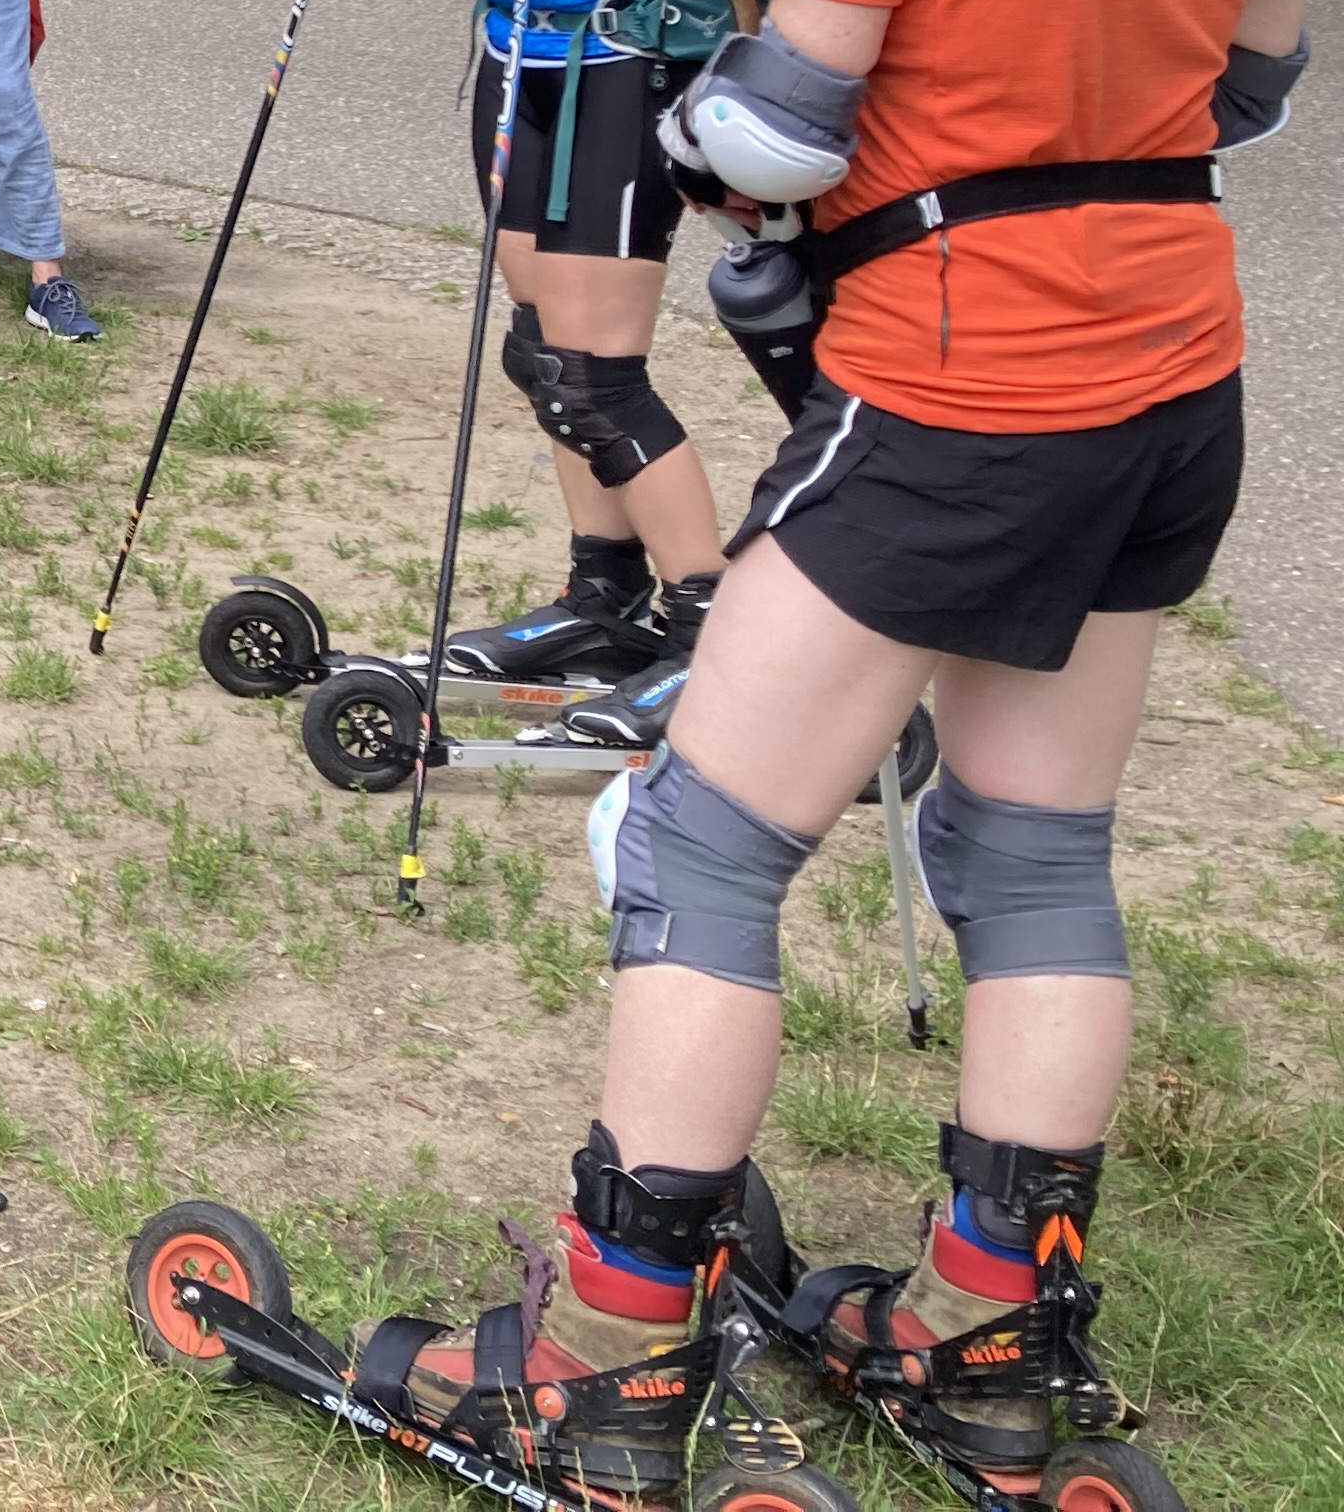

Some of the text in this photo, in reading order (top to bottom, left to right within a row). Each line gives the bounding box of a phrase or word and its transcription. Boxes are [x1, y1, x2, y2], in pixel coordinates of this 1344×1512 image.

[499, 687, 564, 704] skike
[643, 669, 691, 699] salomo
[426, 1442, 546, 1512] PLUS
